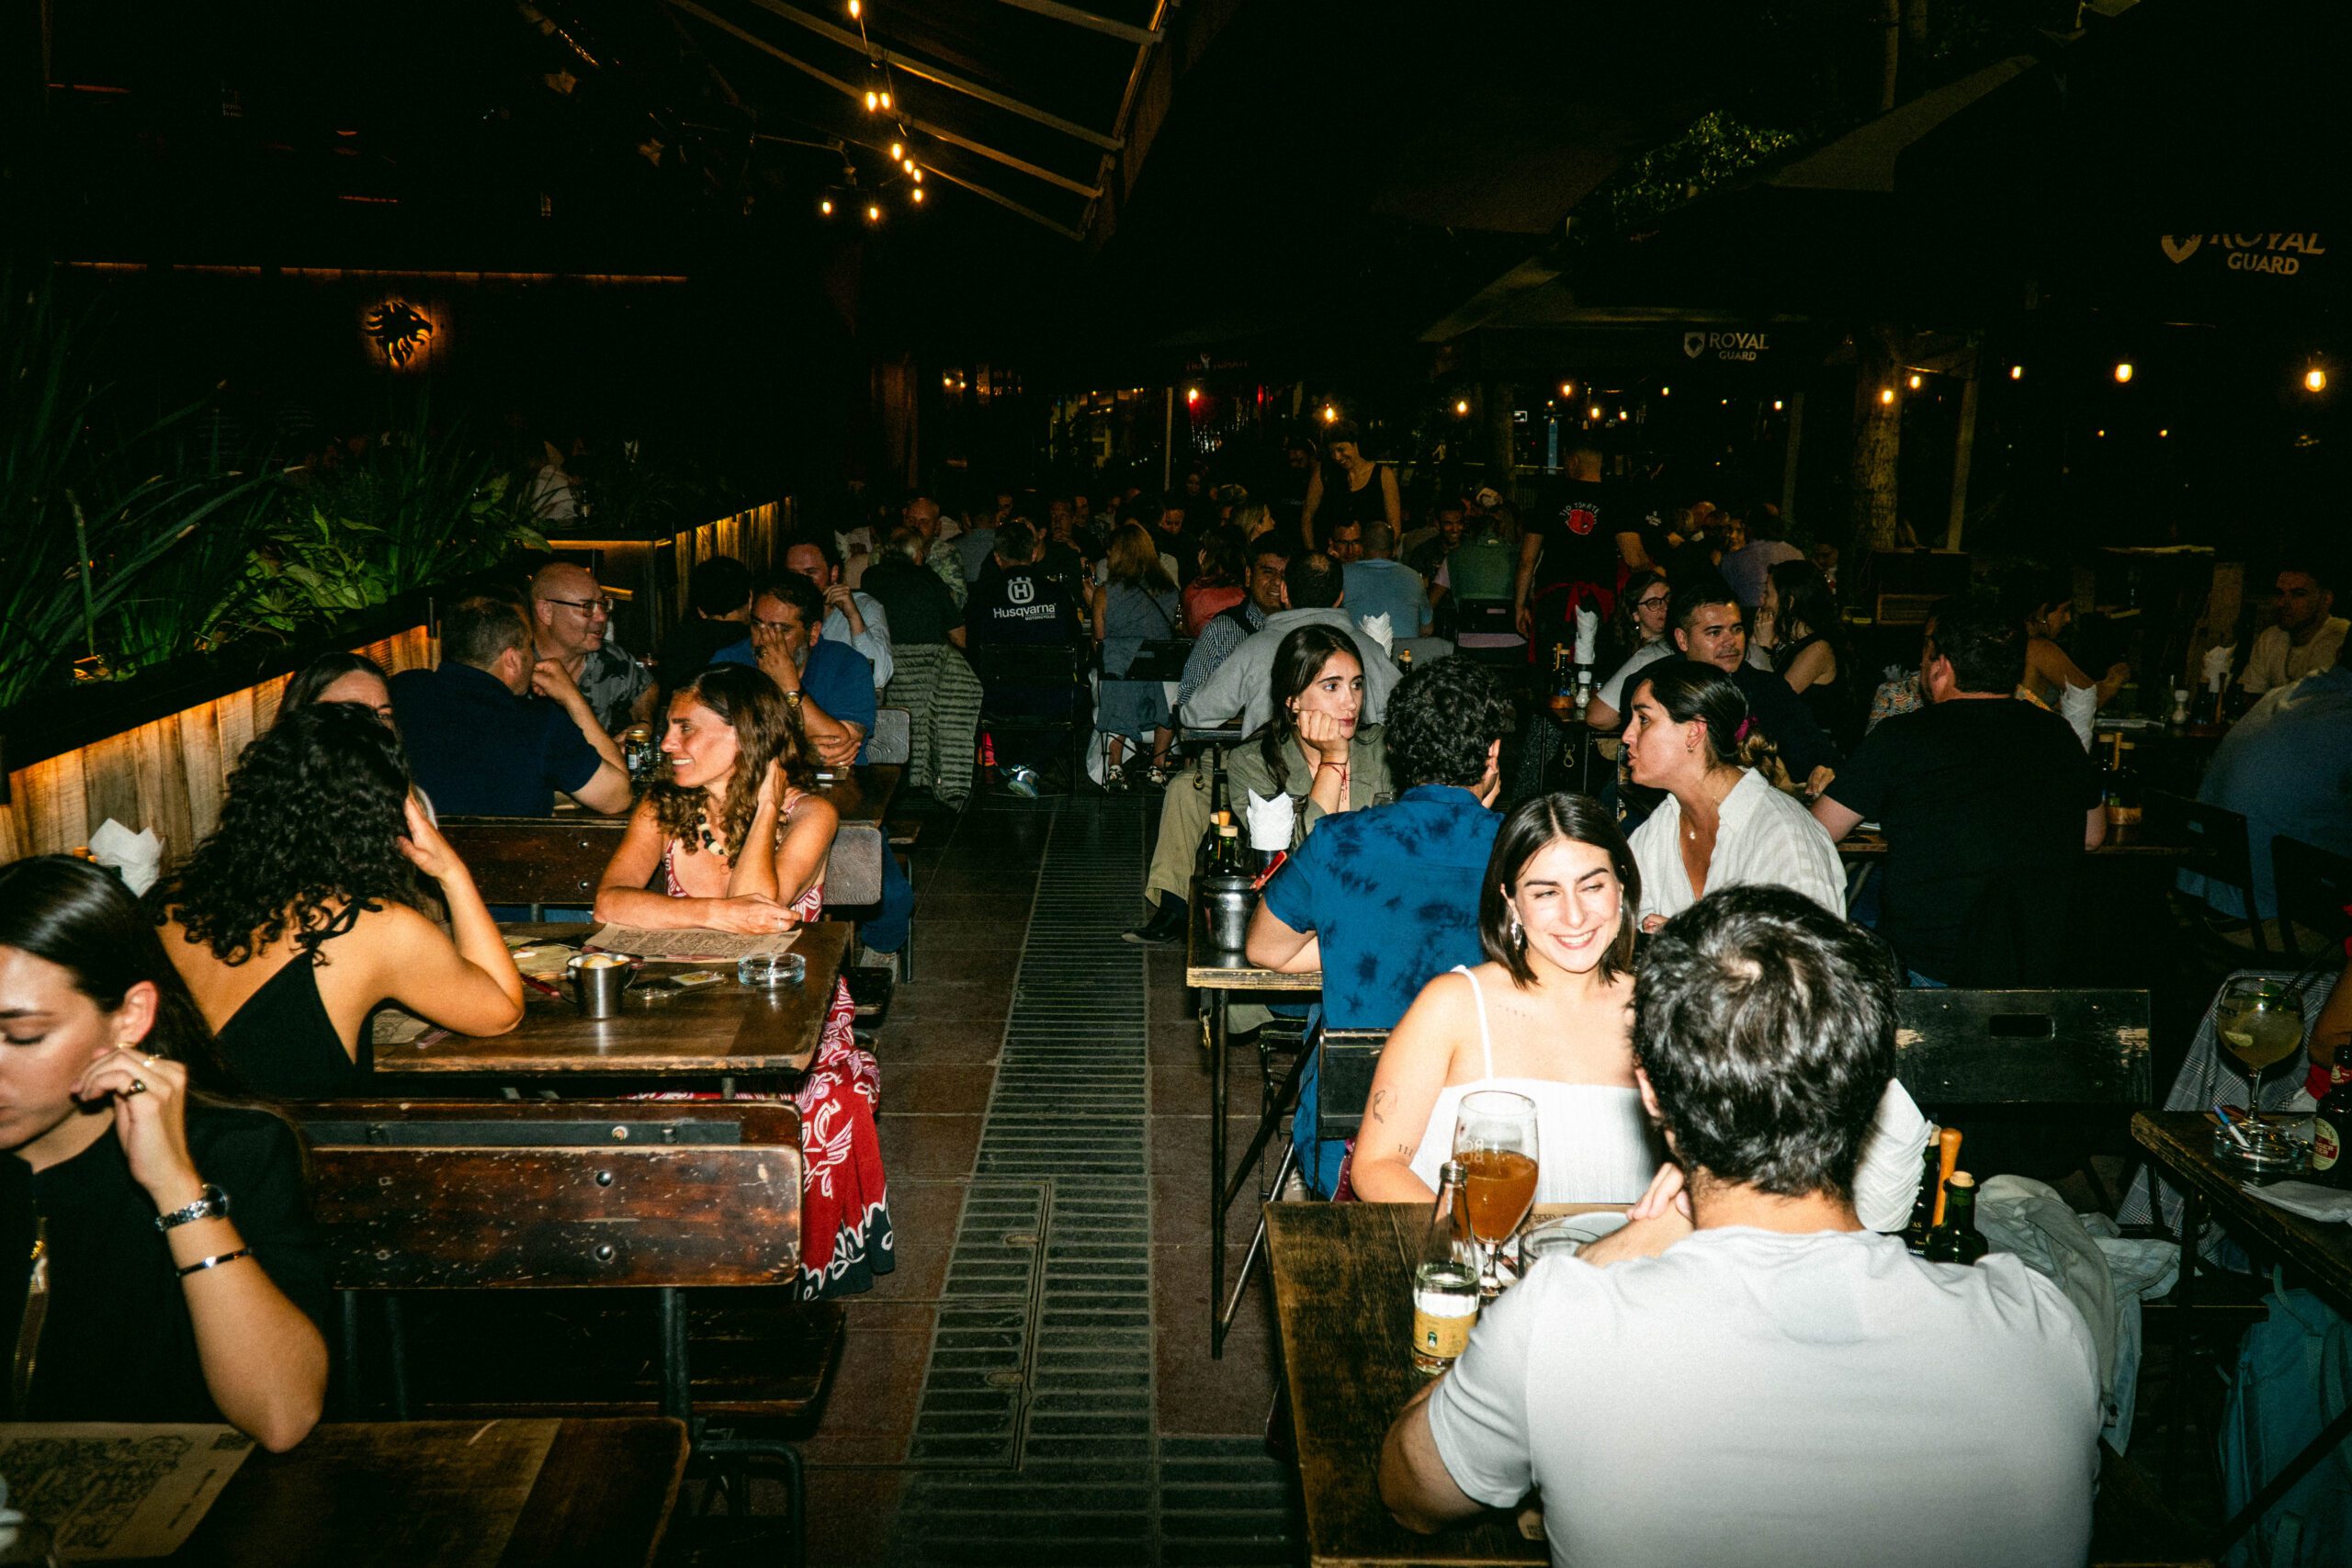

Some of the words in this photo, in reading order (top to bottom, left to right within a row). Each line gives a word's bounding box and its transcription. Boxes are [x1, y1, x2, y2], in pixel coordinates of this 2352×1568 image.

[2227, 252, 2300, 276] GUARD
[1709, 333, 1770, 350] ROYAL
[1718, 351, 1757, 361] GUARD
[1013, 583, 1028, 599] H
[992, 604, 1056, 619] Husqvarna
